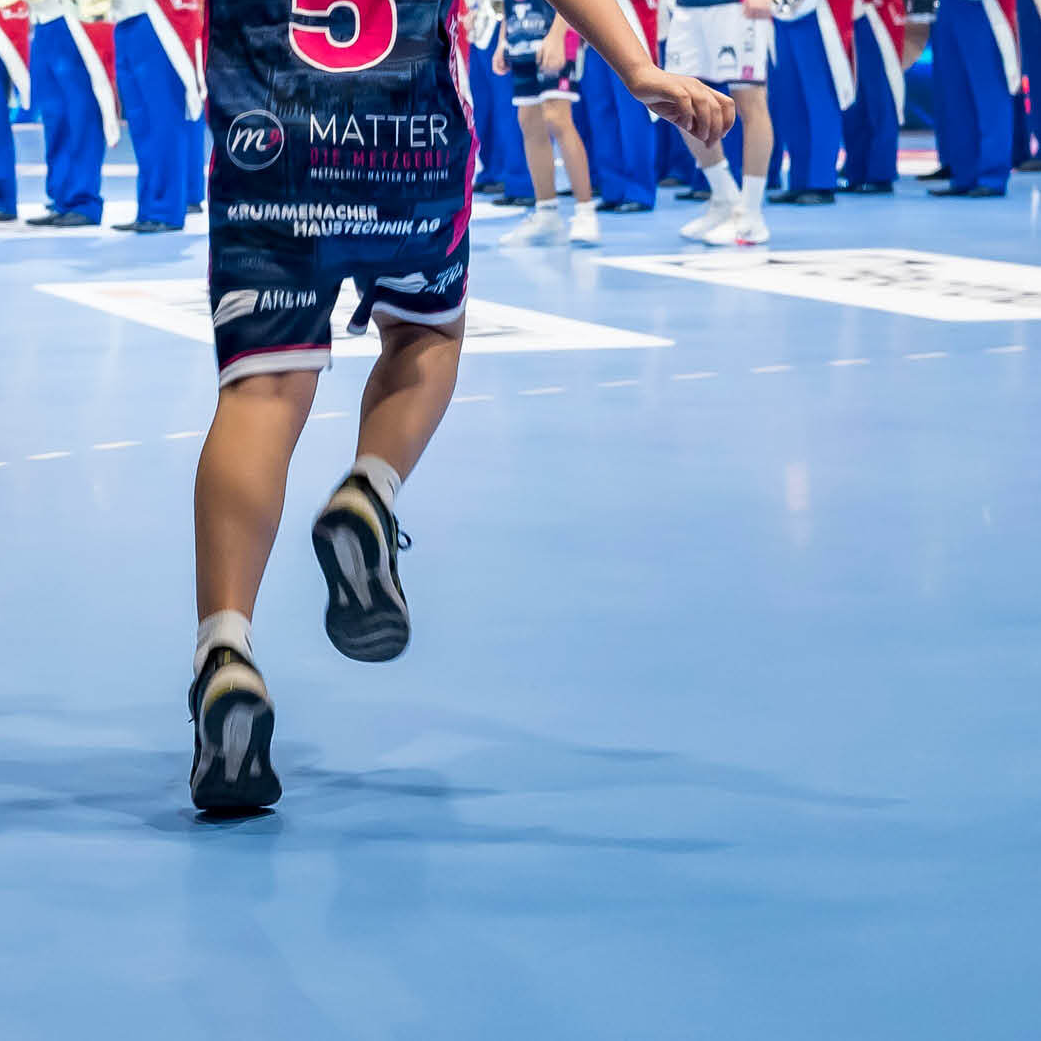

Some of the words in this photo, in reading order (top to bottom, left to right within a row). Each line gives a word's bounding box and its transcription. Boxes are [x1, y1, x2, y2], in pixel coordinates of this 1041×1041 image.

[310, 114, 449, 148] MATTER
[227, 203, 378, 221] KRUMMENACHER
[293, 219, 412, 237] HAUSTECHNIK
